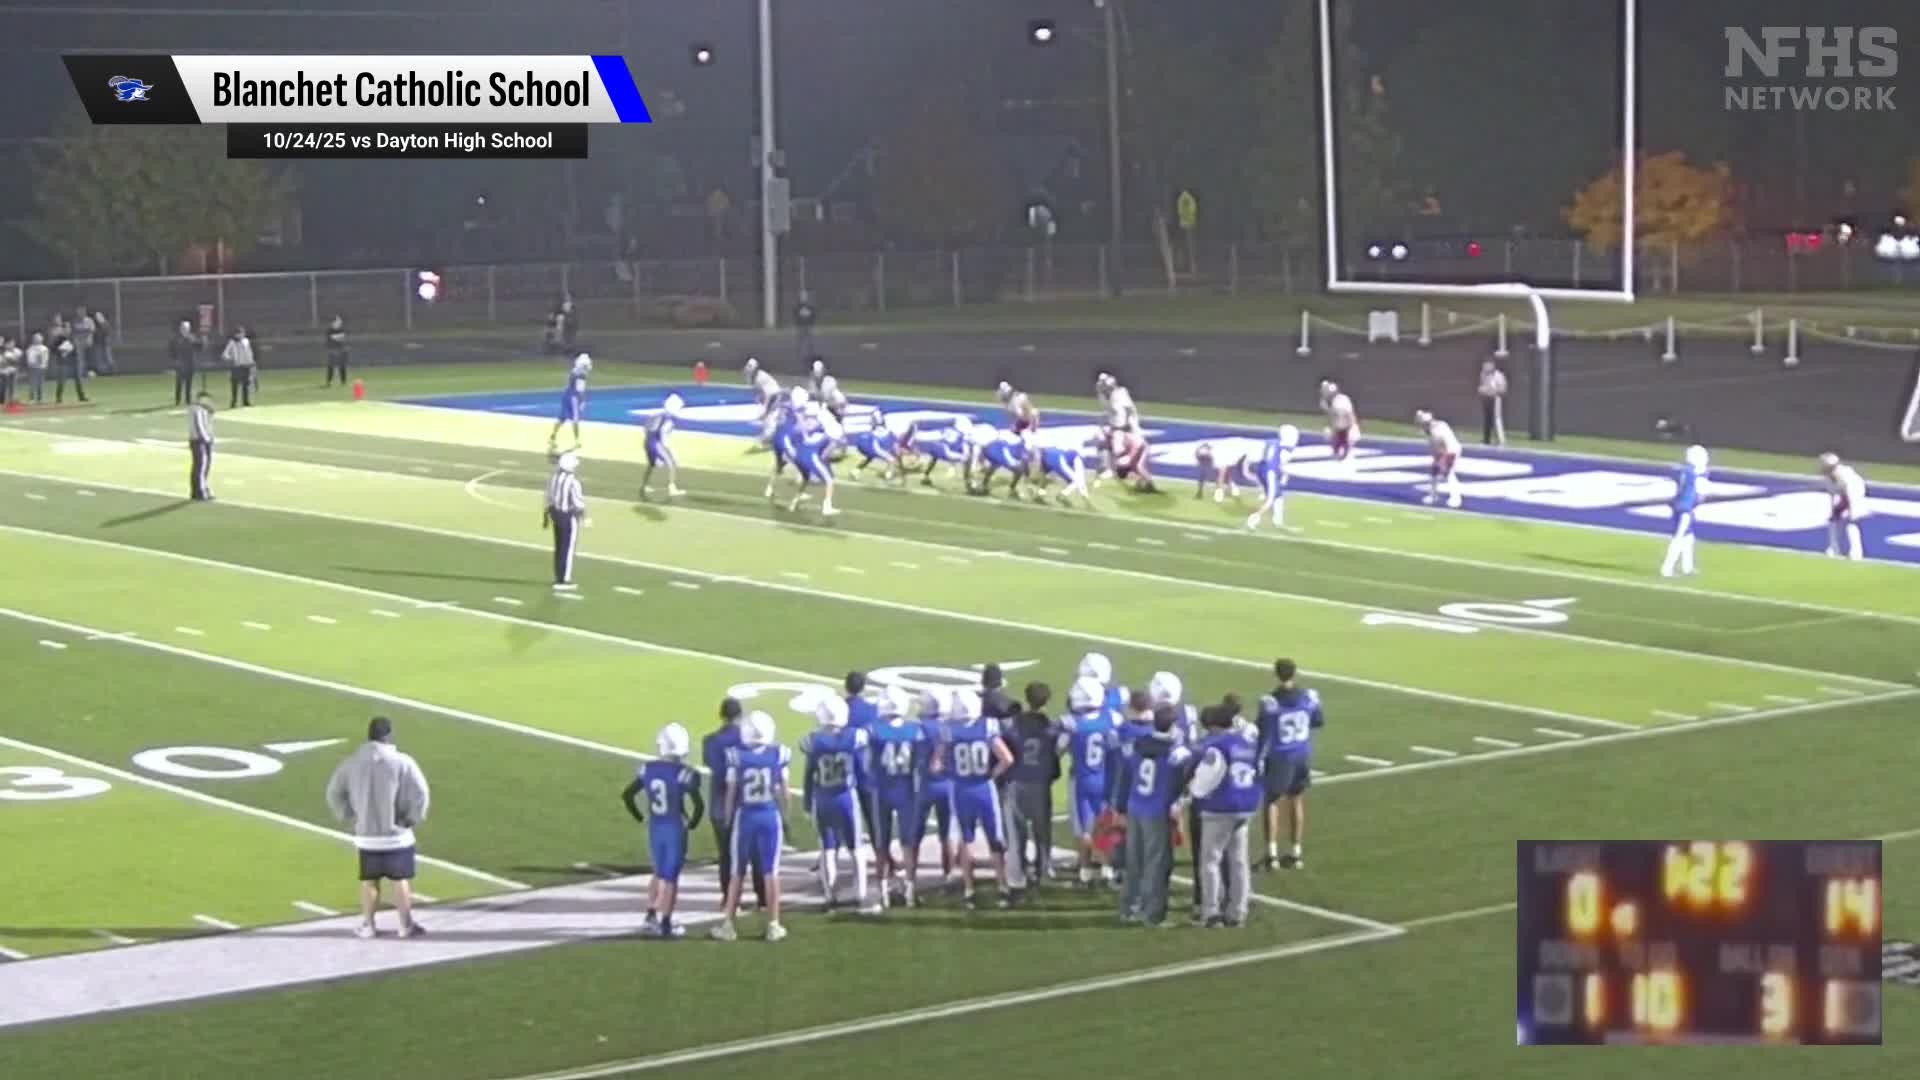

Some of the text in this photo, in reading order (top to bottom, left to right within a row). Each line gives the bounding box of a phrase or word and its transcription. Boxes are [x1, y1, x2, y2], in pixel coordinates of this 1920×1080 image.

[1361, 602, 1569, 633] 10
[954, 741, 990, 777] 80
[1024, 738, 1041, 766] 2
[1086, 732, 1104, 767] 6
[743, 767, 772, 804] 21
[1137, 758, 1155, 796] 9
[650, 778, 668, 815] 3
[1825, 878, 1876, 934] 14
[1632, 970, 1683, 1030] 10
